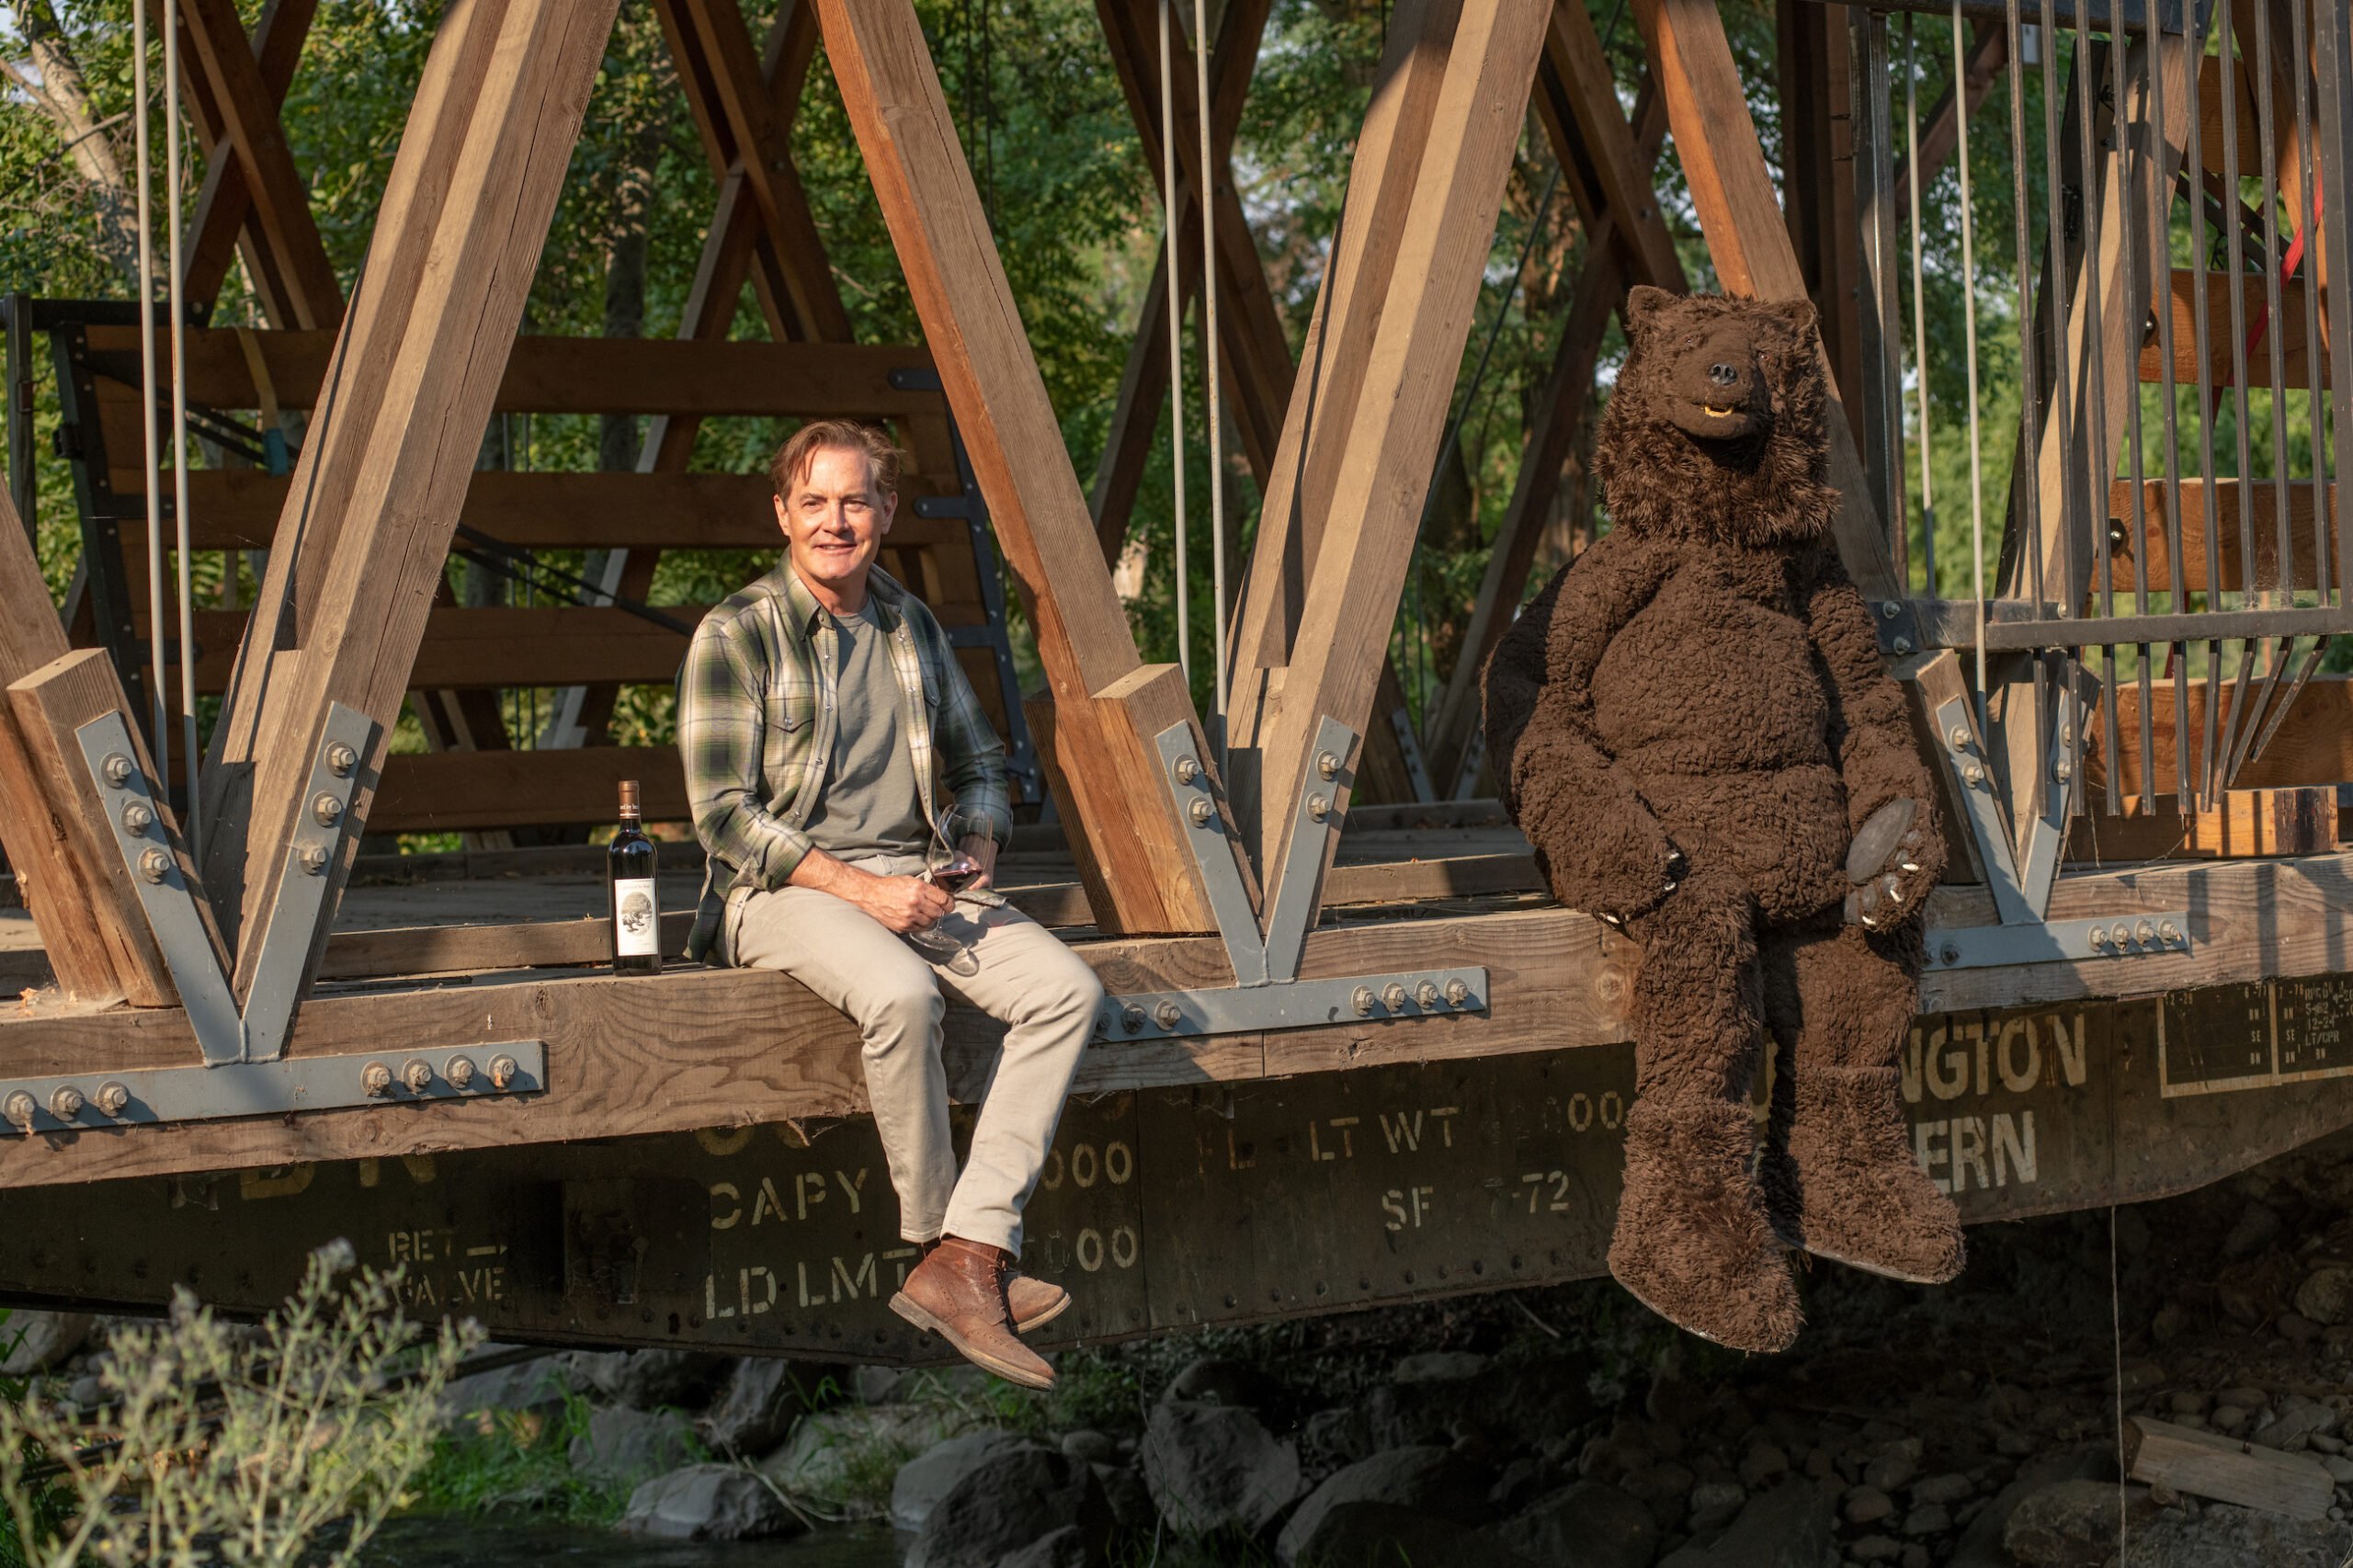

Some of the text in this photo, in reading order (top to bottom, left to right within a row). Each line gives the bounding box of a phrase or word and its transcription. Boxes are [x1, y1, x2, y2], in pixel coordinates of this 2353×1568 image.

[2251, 1030, 2260, 1042] SE
[2286, 1029, 2295, 1040] SE
[1309, 1116, 1360, 1162] LT
[1379, 1106, 1461, 1154] WT
[709, 1168, 870, 1229] CAPY
[1381, 1186, 1435, 1232] SF
